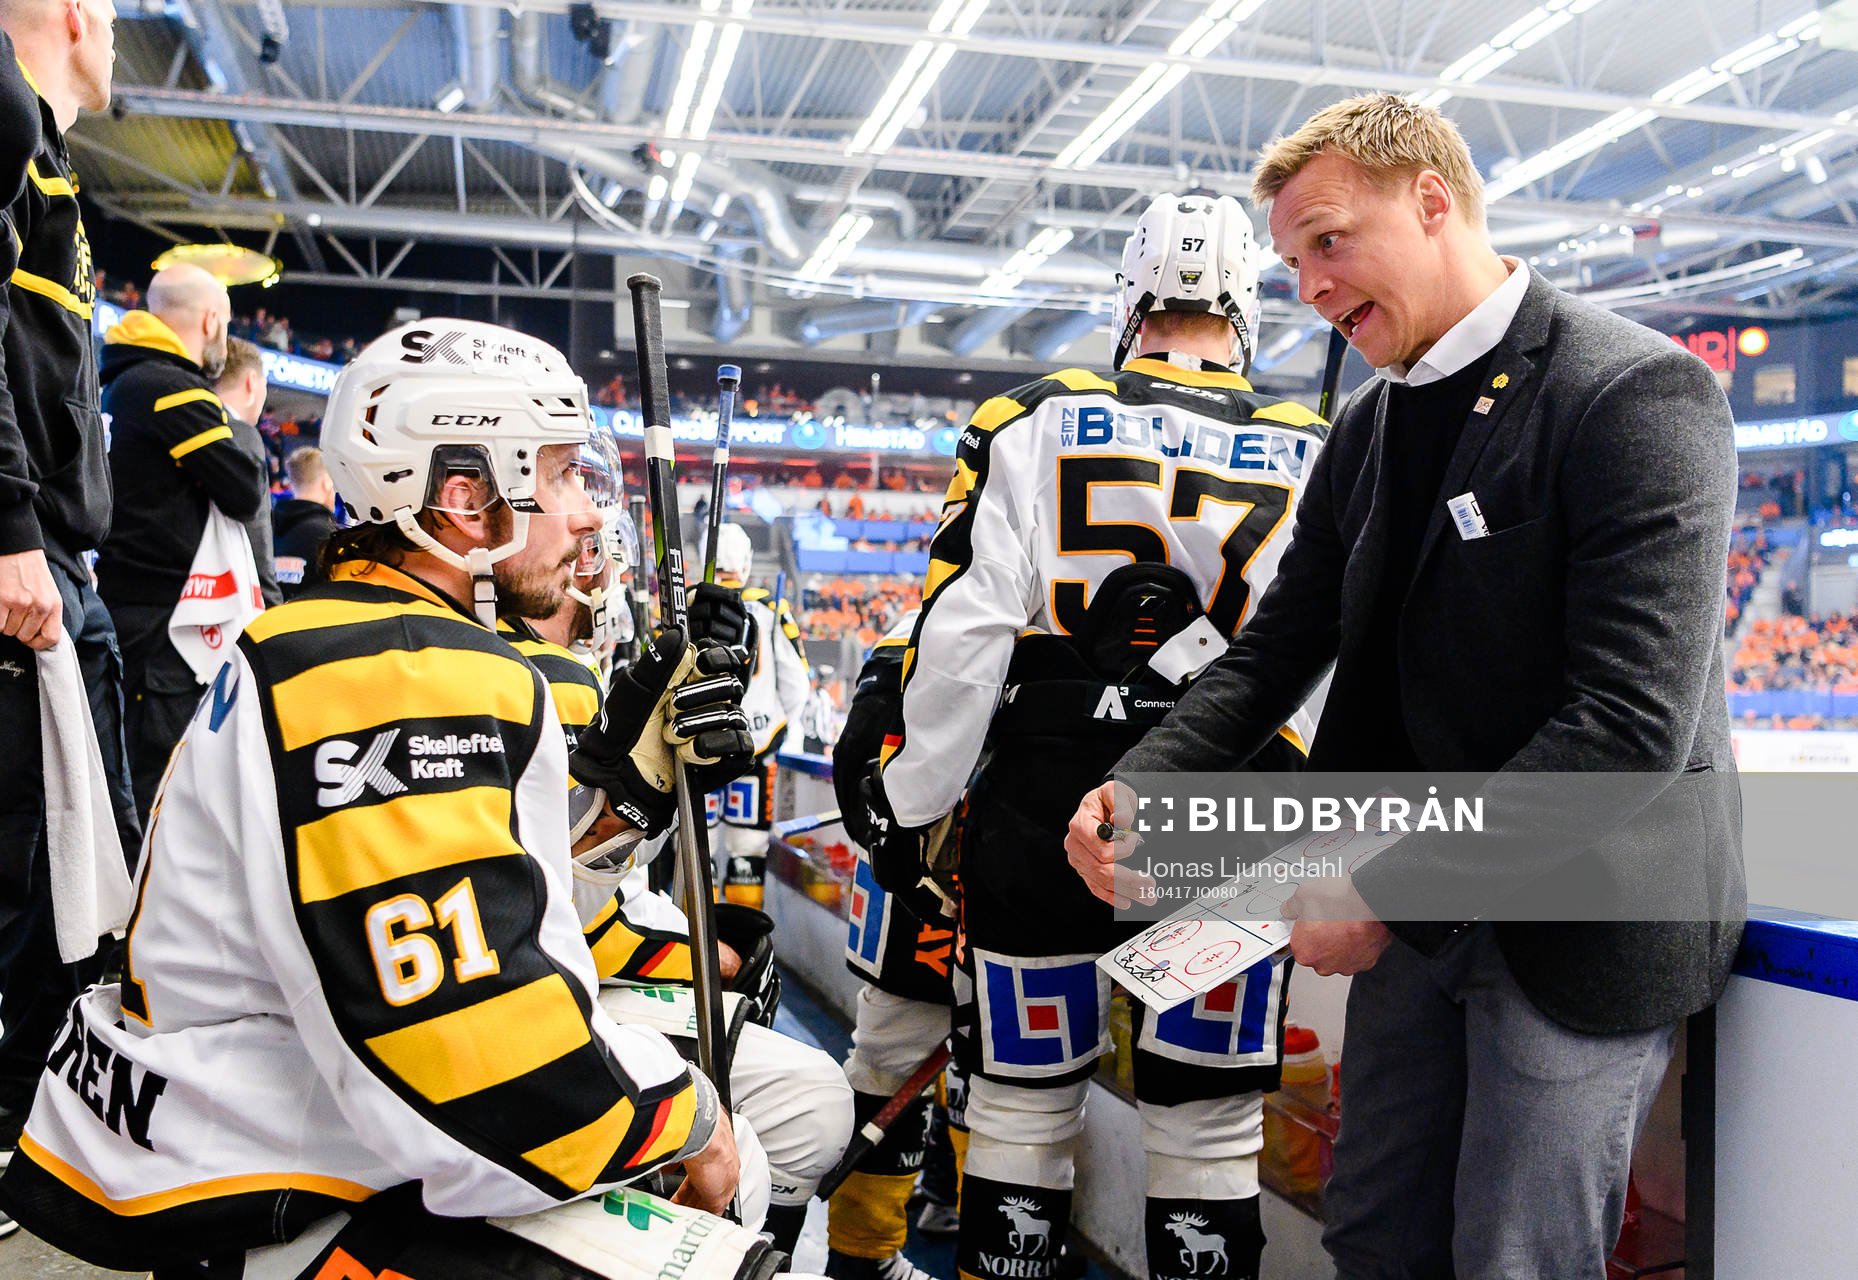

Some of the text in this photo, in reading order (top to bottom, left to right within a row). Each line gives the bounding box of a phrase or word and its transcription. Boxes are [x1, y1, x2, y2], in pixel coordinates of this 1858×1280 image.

[1181, 238, 1205, 252] 57
[1150, 382, 1227, 401] CCM
[431, 414, 502, 427] CCM
[511, 500, 536, 509] CCM
[1050, 453, 1295, 638] 57
[1134, 699, 1176, 709] Connect
[408, 733, 505, 756] Skellefte
[410, 758, 465, 779] Kraft
[364, 876, 500, 1007] 61
[977, 1250, 1057, 1279] NORRA
